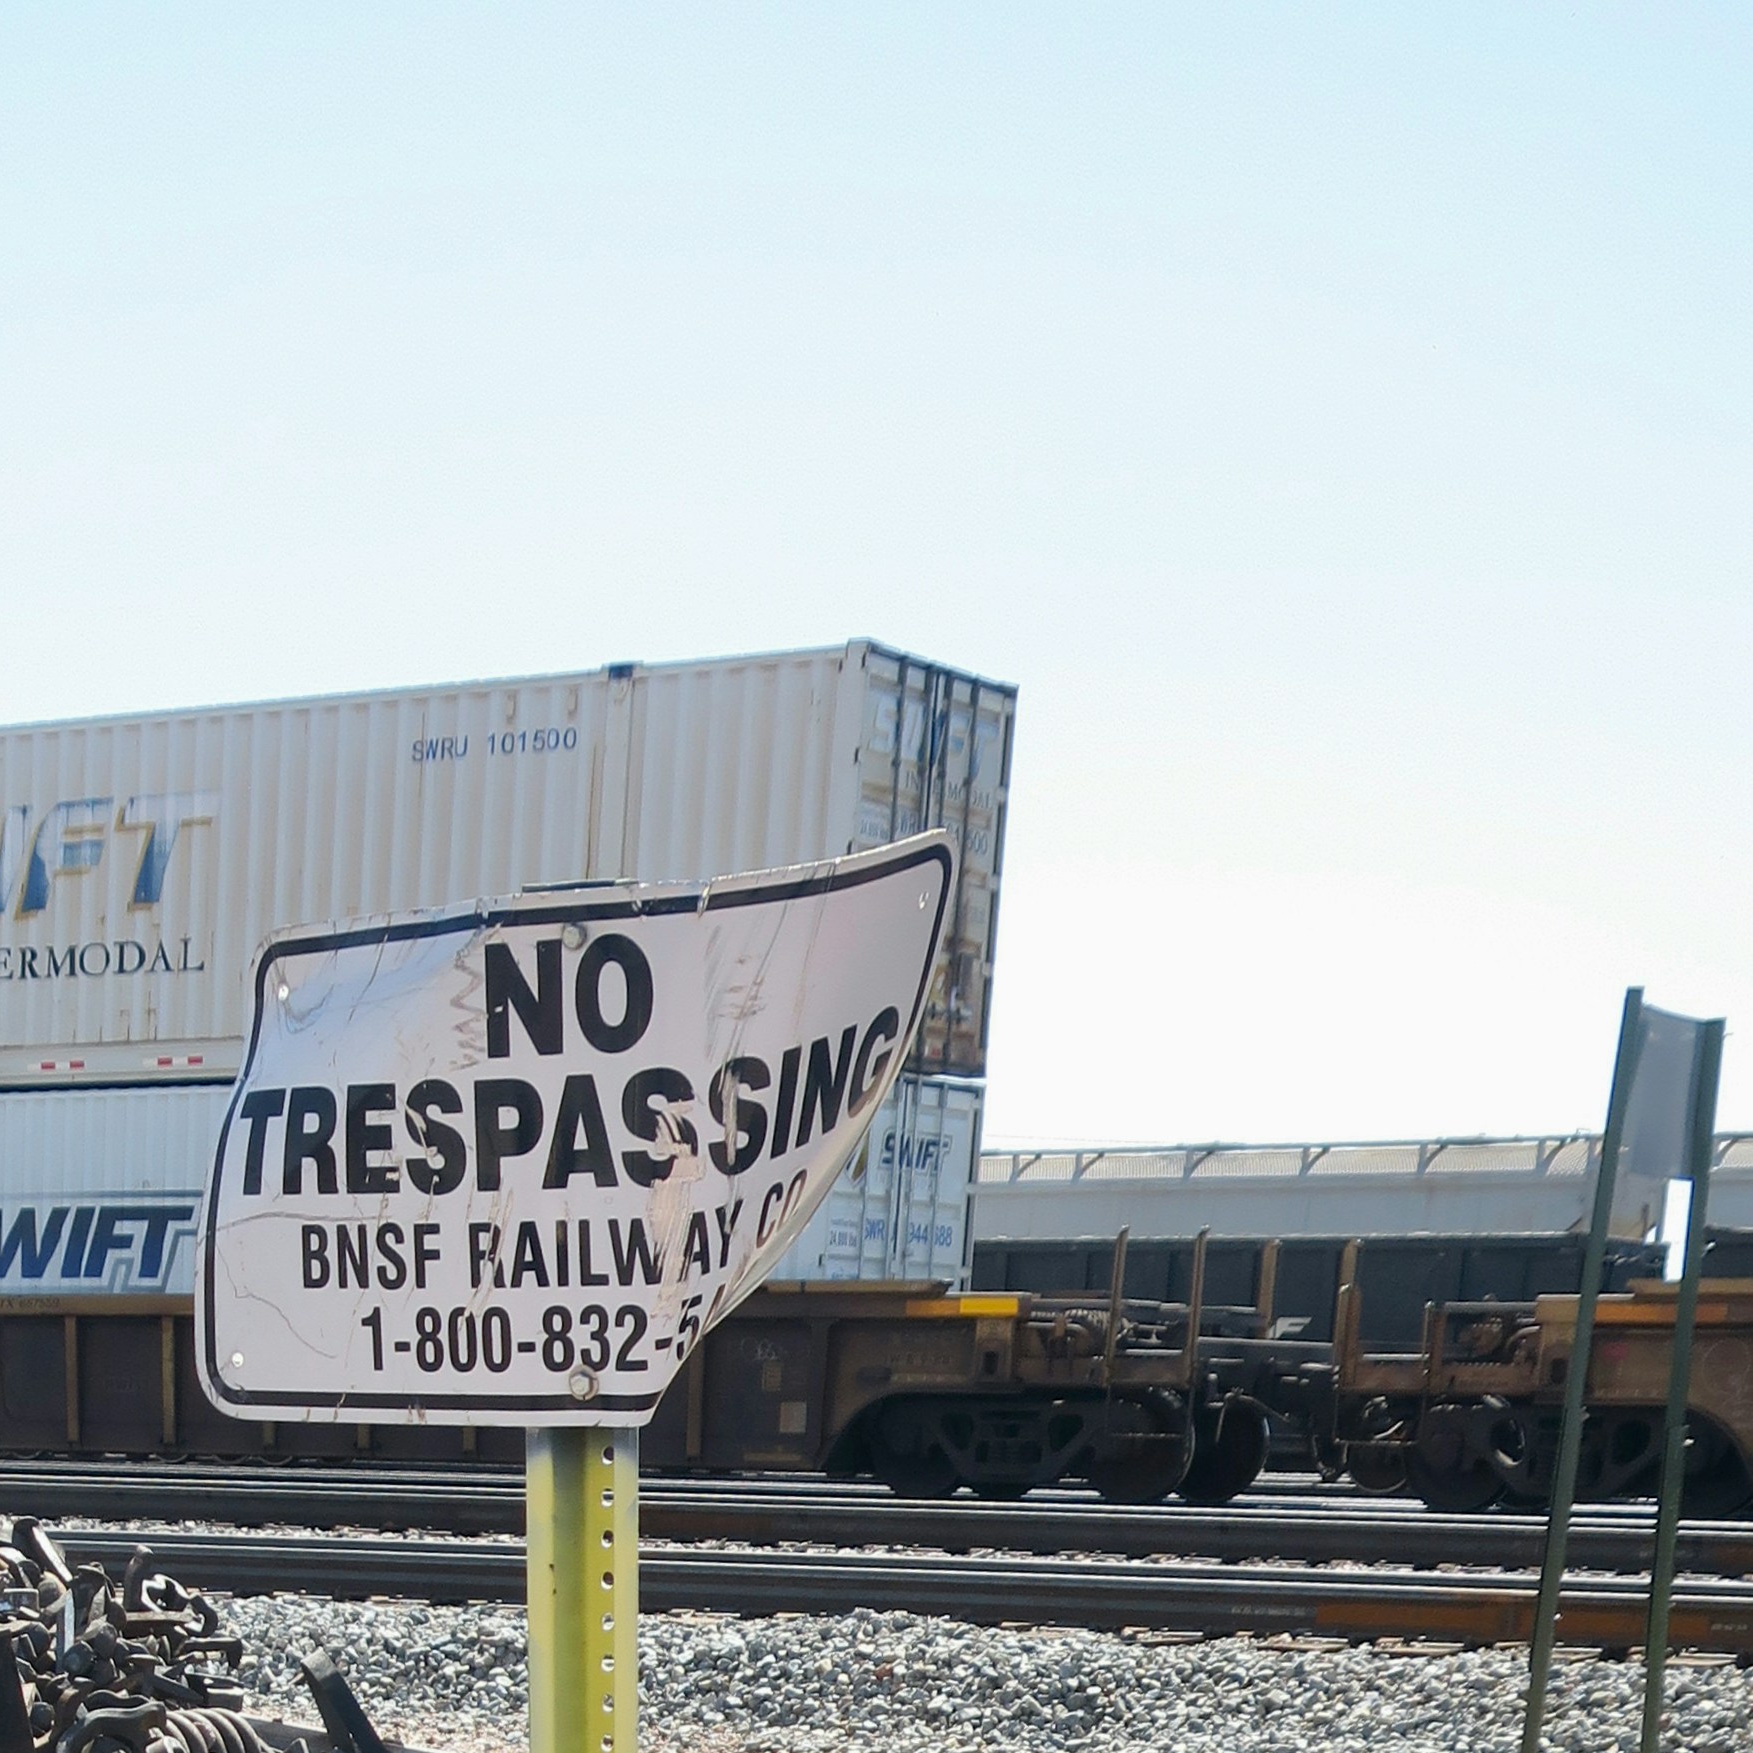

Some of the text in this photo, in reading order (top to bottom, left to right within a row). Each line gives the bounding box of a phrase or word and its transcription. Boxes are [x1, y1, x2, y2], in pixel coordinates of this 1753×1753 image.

[412, 727, 577, 762] SWRU 101500
[483, 933, 654, 1060] NO
[240, 1006, 899, 1196] TRESPASSING
[882, 1131, 951, 1171] SWIFT
[301, 1221, 442, 1291] BNSF
[468, 1199, 744, 1291] RAILWAY
